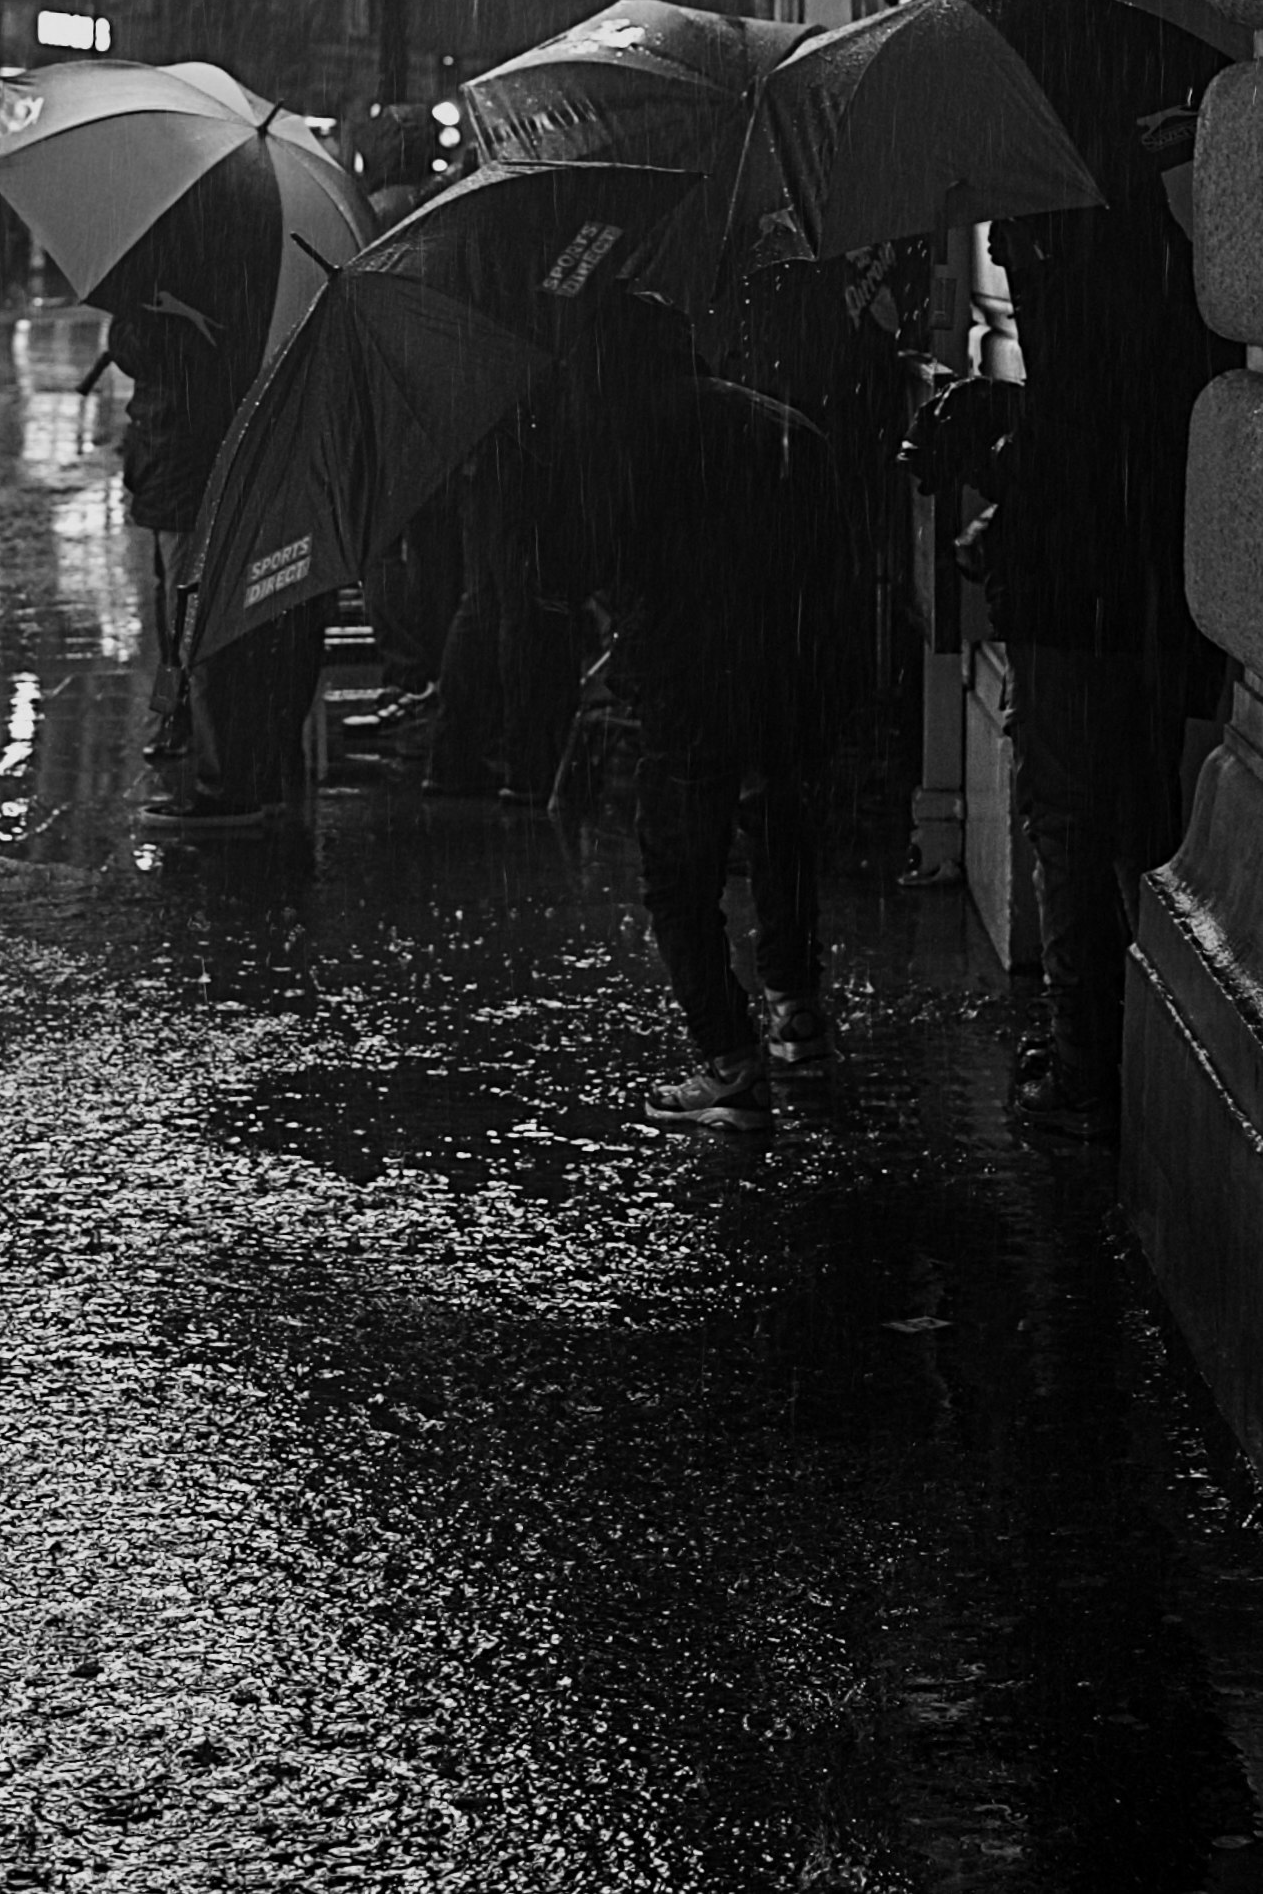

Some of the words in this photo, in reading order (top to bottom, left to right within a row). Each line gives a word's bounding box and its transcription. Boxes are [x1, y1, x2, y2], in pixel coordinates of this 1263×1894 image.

[541, 224, 598, 290] SPORTS
[561, 228, 617, 296] DIRECT
[247, 558, 310, 605] DIRECT
[250, 534, 311, 580] SPORTS
